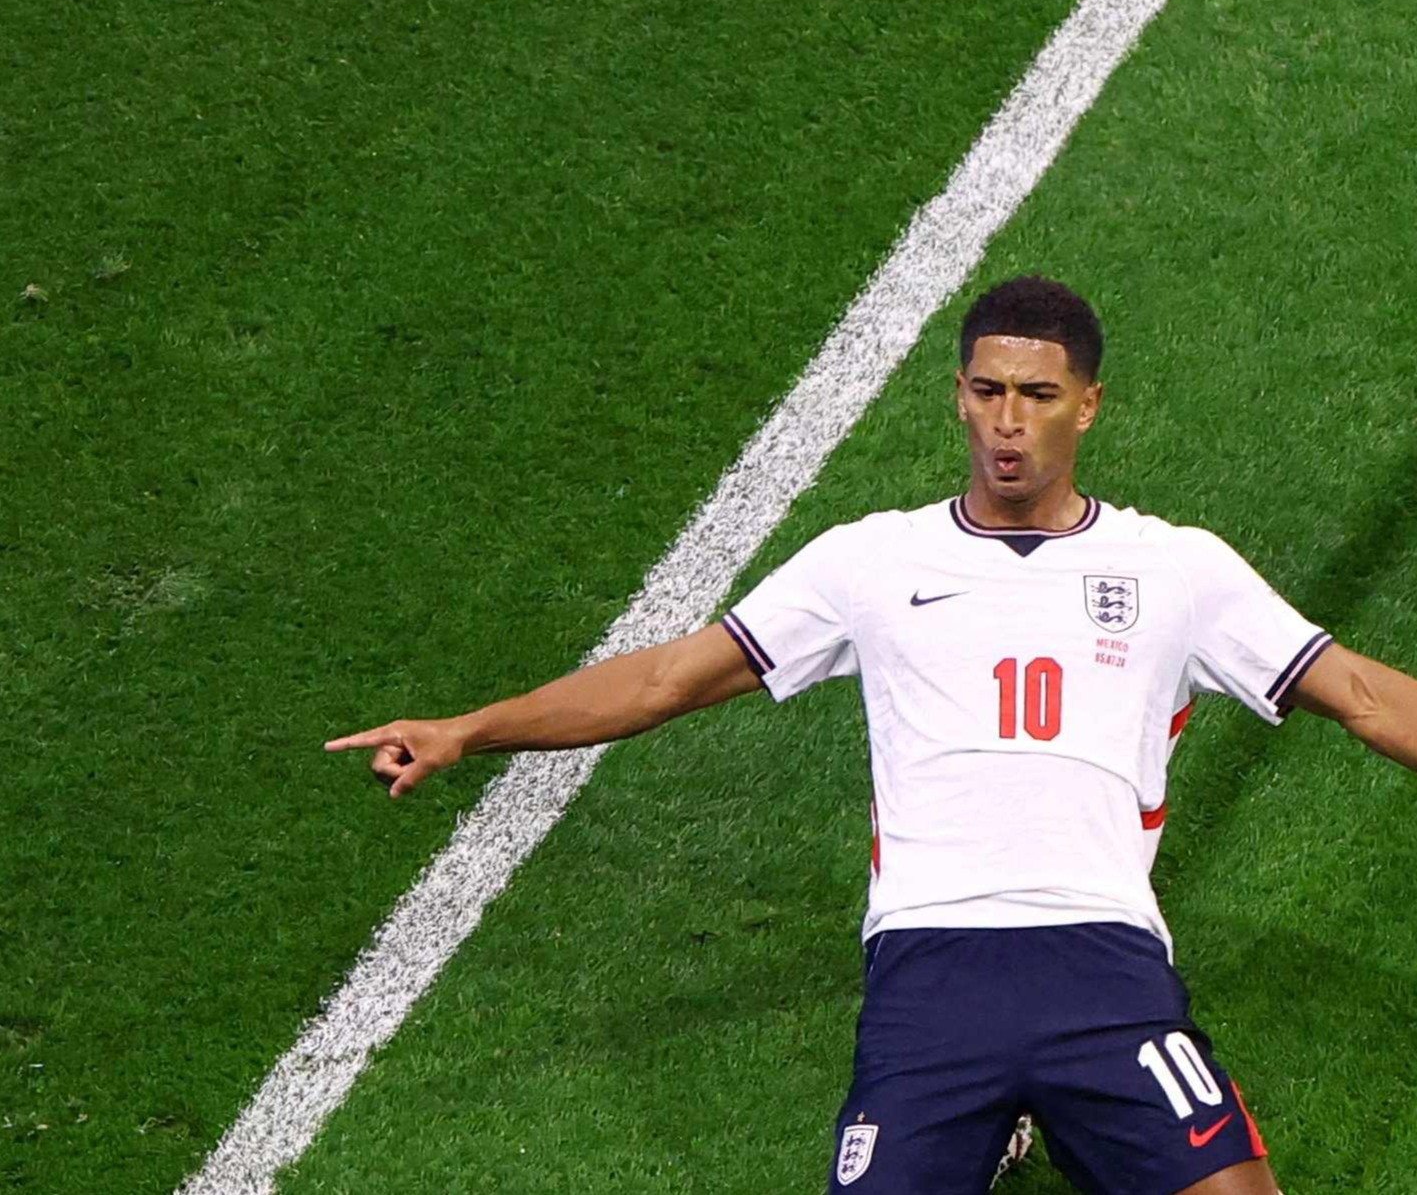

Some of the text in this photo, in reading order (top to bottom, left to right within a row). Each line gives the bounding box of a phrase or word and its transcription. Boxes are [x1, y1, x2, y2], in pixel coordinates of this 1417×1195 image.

[1096, 638, 1129, 653] MEXICO
[993, 656, 1064, 742] 10
[1137, 1031, 1223, 1120] 10
